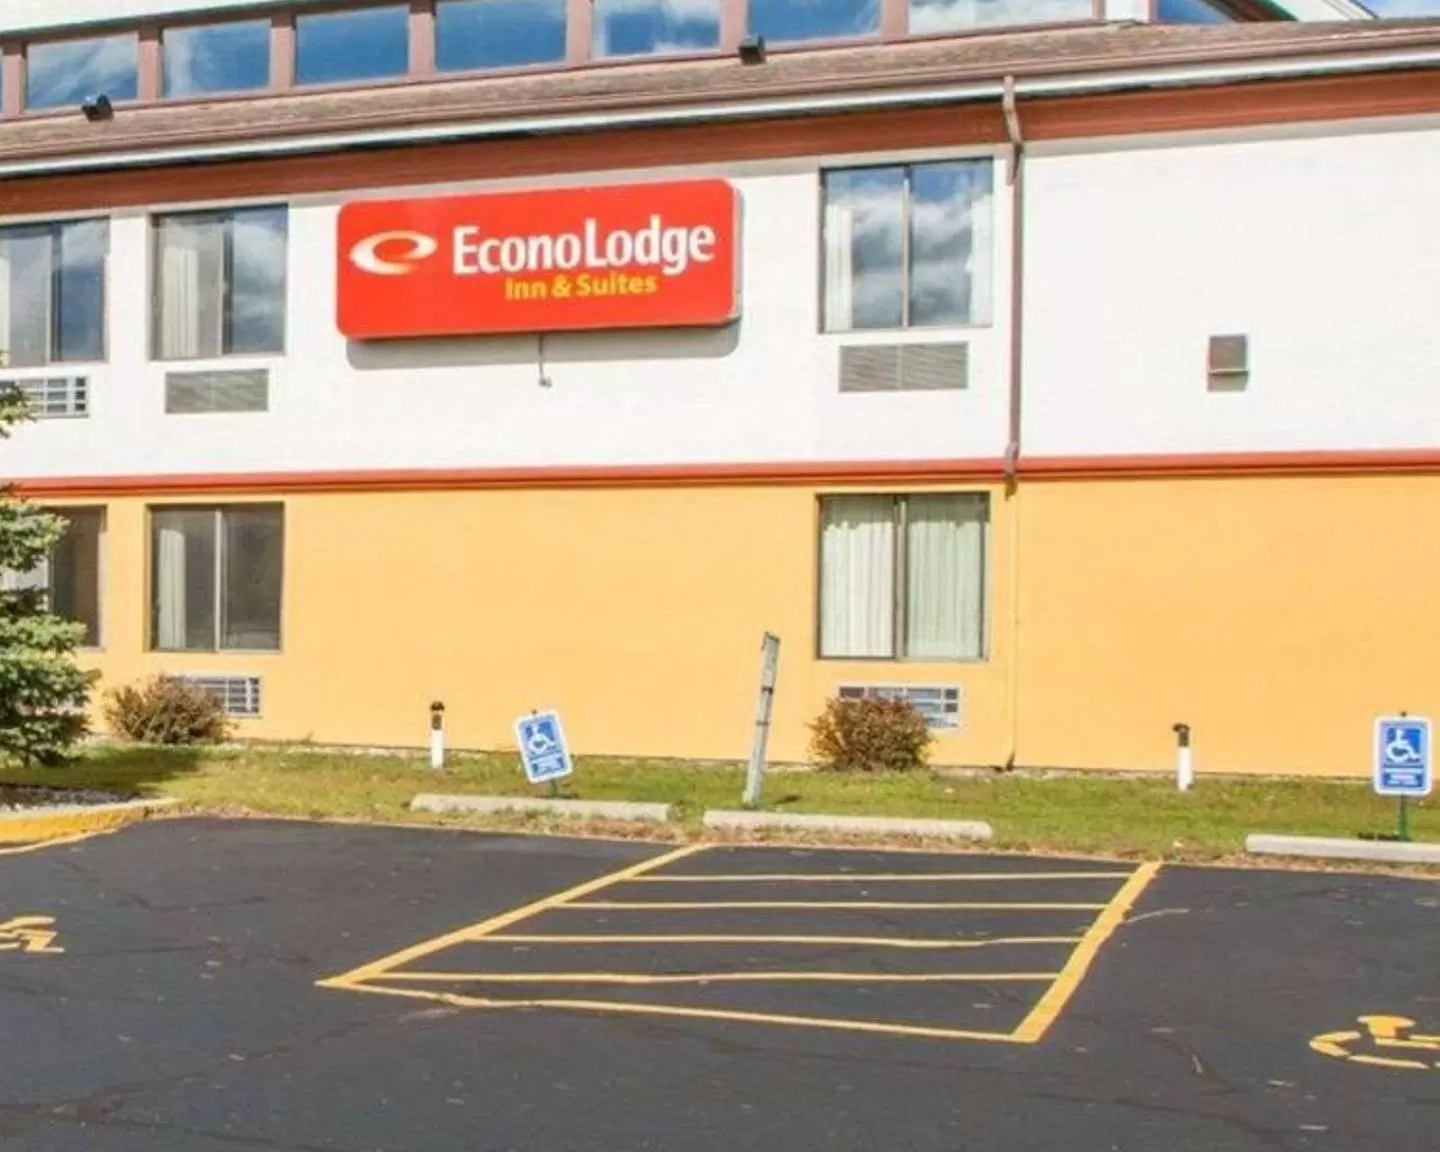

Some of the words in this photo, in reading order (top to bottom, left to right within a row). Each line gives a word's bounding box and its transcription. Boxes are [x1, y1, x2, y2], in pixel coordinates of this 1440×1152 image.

[453, 215, 716, 276] EconoLodge
[505, 277, 547, 300] Inn
[551, 275, 572, 298] &
[576, 273, 657, 297] Suites
